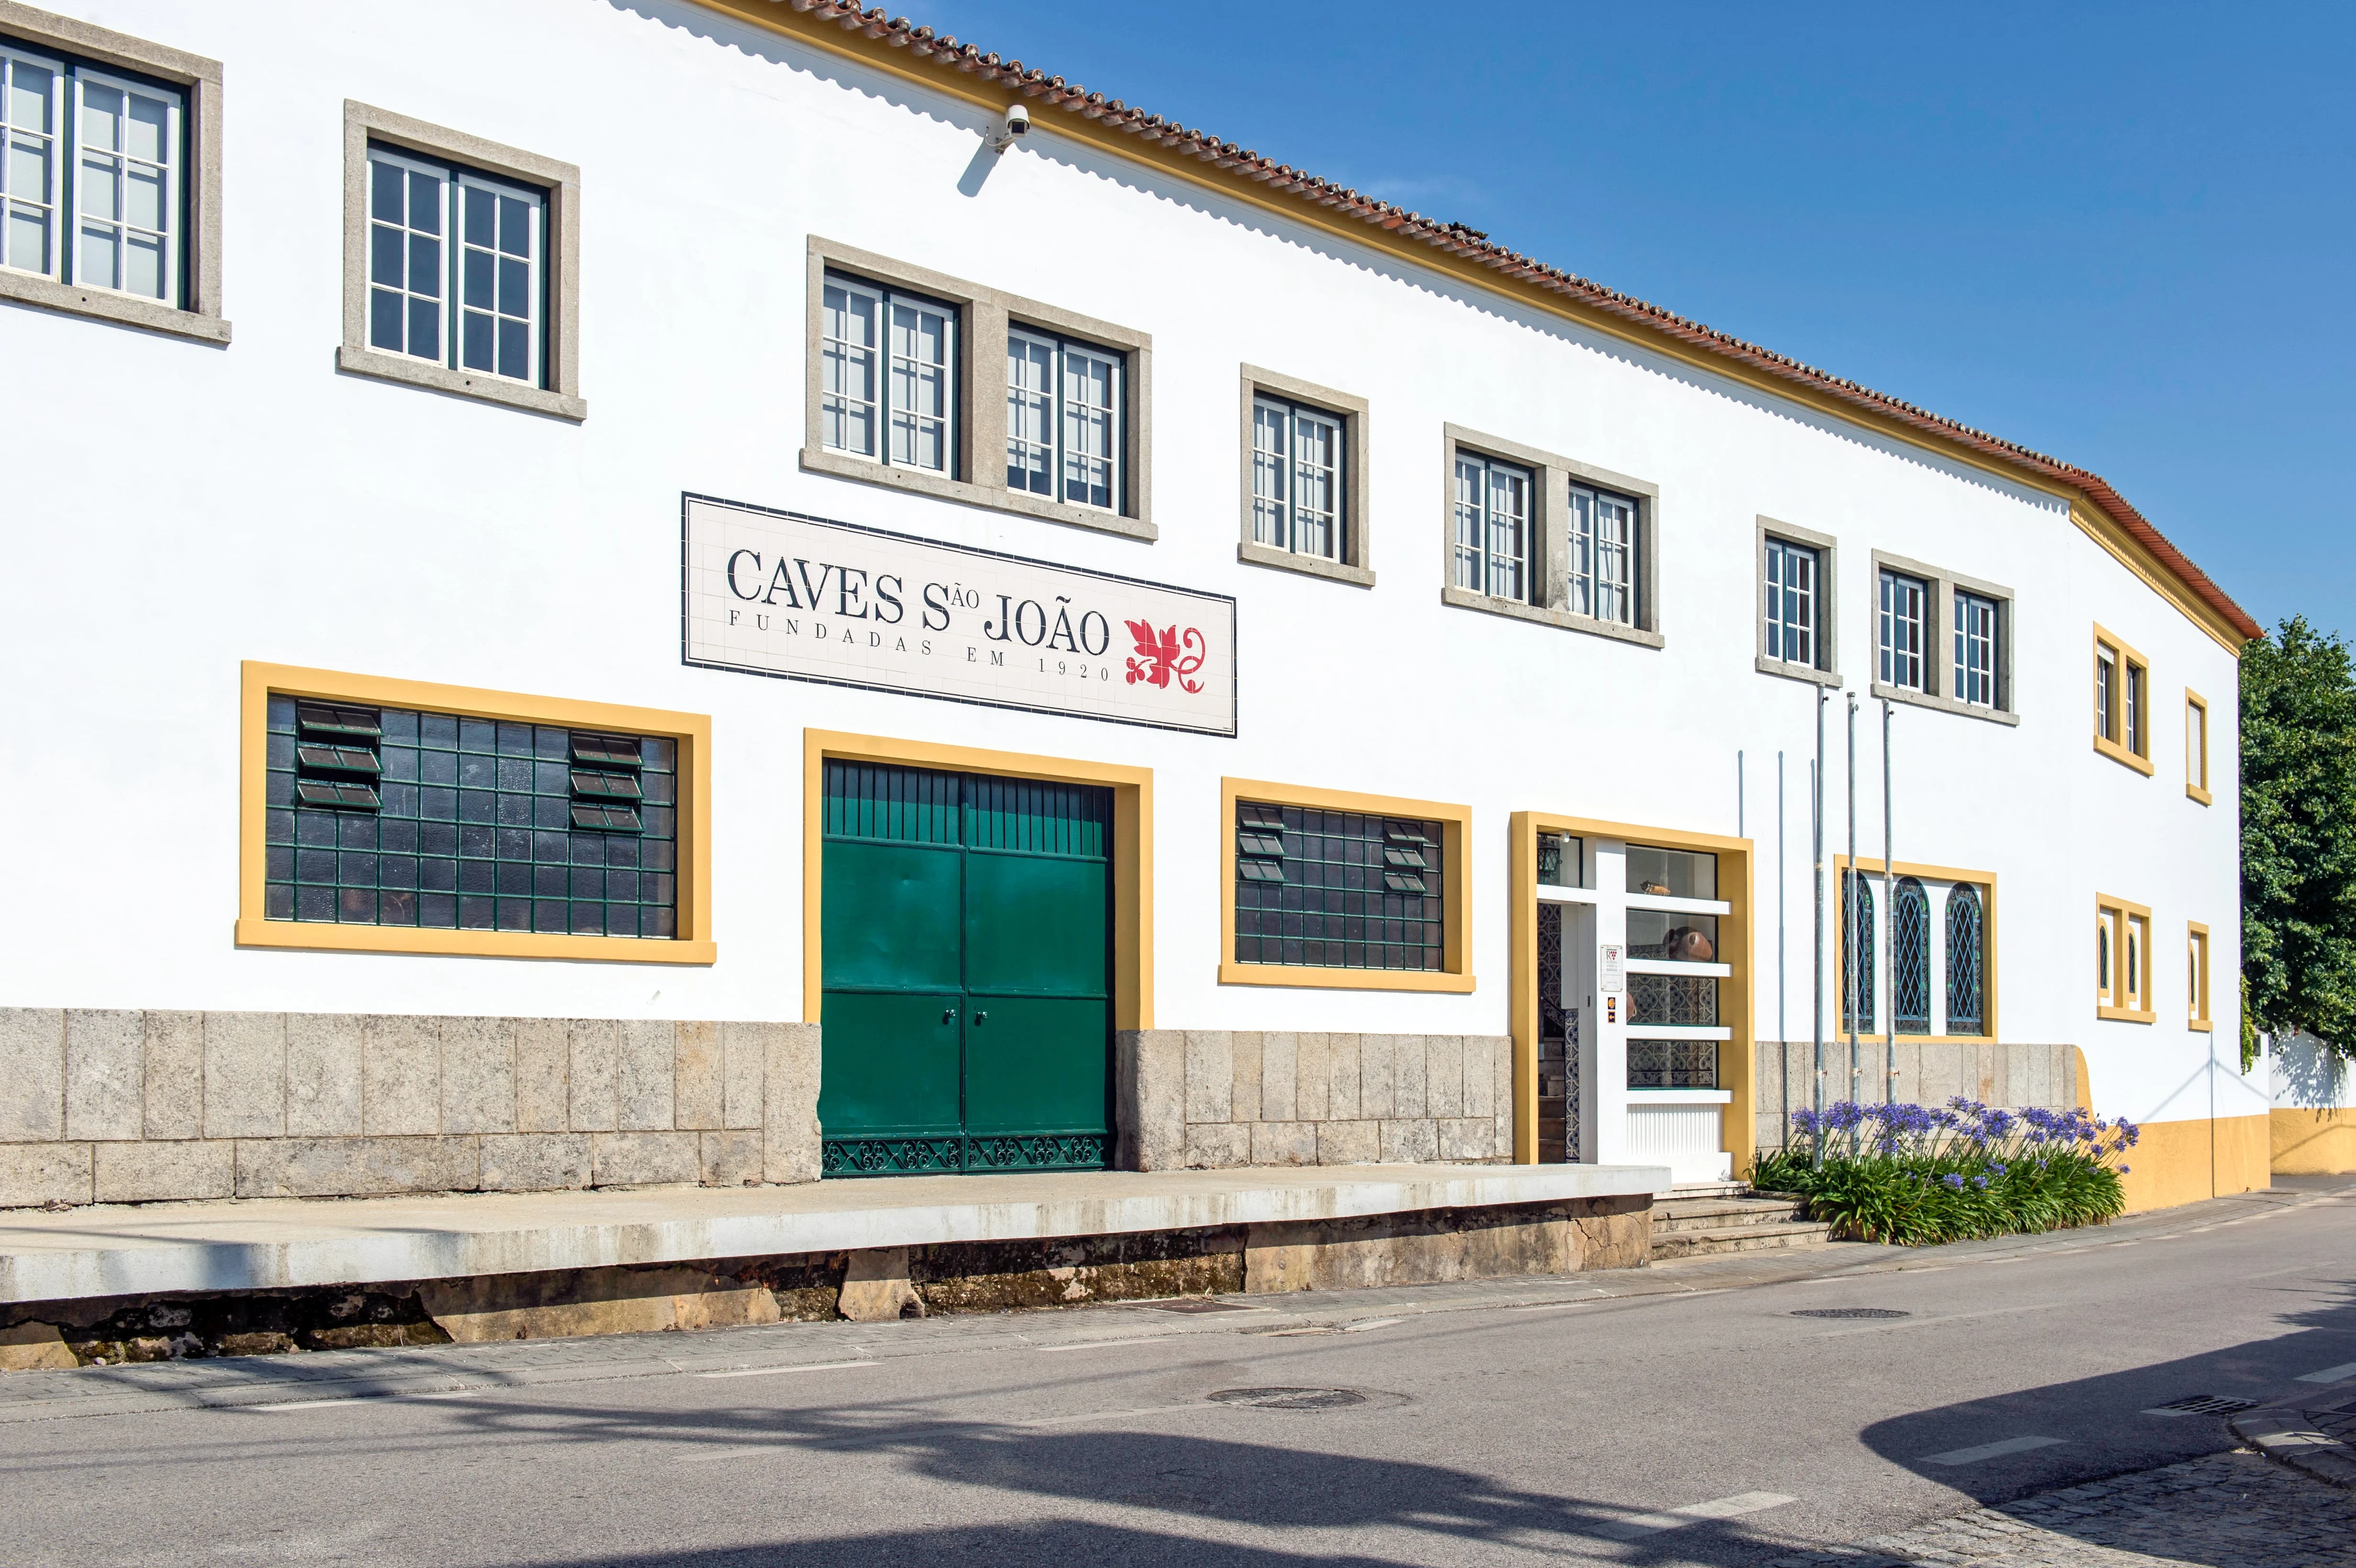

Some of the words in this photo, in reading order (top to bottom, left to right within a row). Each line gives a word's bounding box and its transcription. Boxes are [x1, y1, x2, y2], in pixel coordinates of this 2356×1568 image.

[727, 549, 904, 624] CAVES
[922, 582, 980, 632] SÃO
[983, 594, 1110, 656] JOÃO
[729, 610, 931, 656] FUNDADAS
[967, 647, 1004, 667] EM
[1039, 658, 1109, 682] 1920
